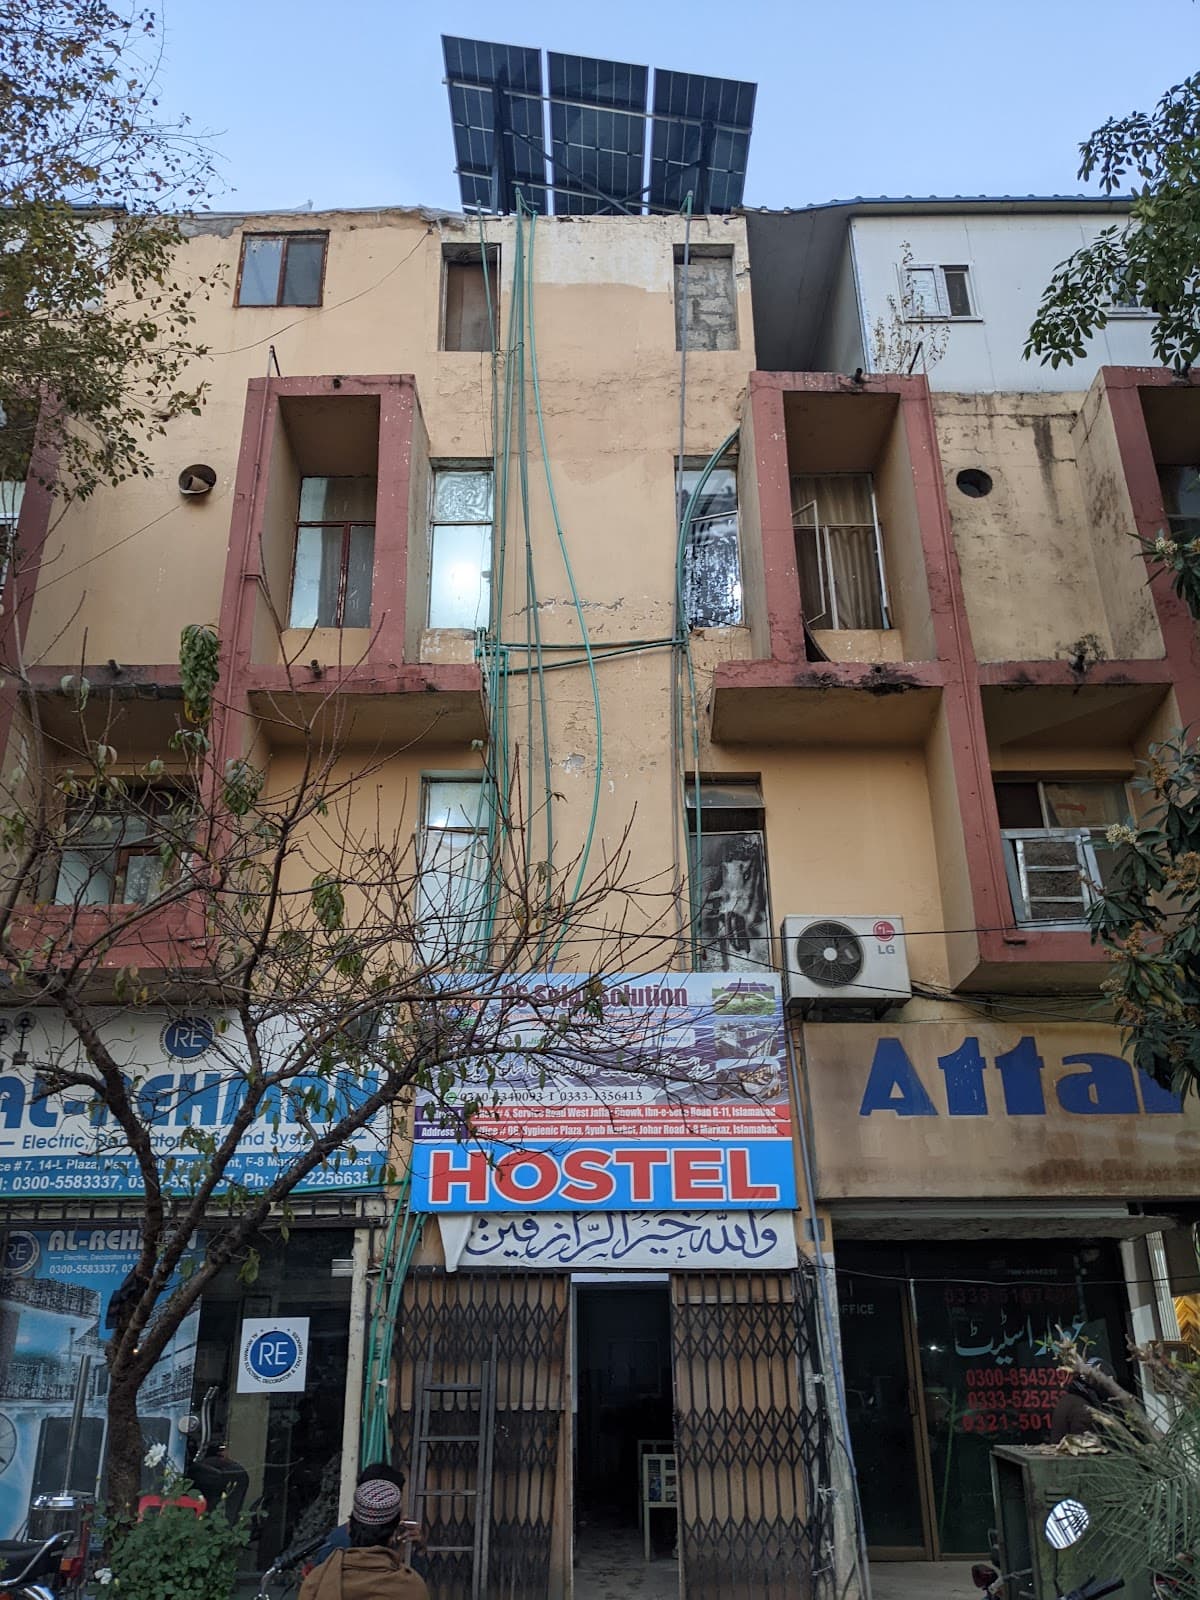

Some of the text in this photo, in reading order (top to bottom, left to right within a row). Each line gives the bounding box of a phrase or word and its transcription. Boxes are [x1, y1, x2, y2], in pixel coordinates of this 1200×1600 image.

[878, 945, 895, 954] LG
[534, 984, 590, 1008] Sola
[600, 984, 688, 1007] Solution
[174, 1027, 203, 1047] RE
[560, 1091, 643, 1101] 0333-1356413
[513, 1108, 544, 1118] Service
[567, 1108, 589, 1117] West
[732, 1107, 776, 1117] Islamabad
[421, 1126, 455, 1137] Address
[560, 1125, 584, 1135] Plaza,
[585, 1125, 606, 1136] Ayub
[639, 1124, 662, 1135] Johar
[663, 1124, 685, 1135] Road
[733, 1124, 778, 1135] Islamabad
[22, 1134, 89, 1150] Electric,
[213, 1131, 264, 1146] Sond
[66, 1158, 100, 1171] Plaza,
[104, 1158, 131, 1169] Near
[246, 1156, 264, 1167] F-8
[12, 1174, 123, 1191] 0300-5583337,
[243, 1172, 269, 1187] Ph:
[275, 1170, 370, 1187] -2256635
[428, 1149, 780, 1204] HOSTEL
[841, 1303, 875, 1314] FFICE
[259, 1341, 289, 1366] RE
[962, 1412, 1054, 1432] 0321-501
